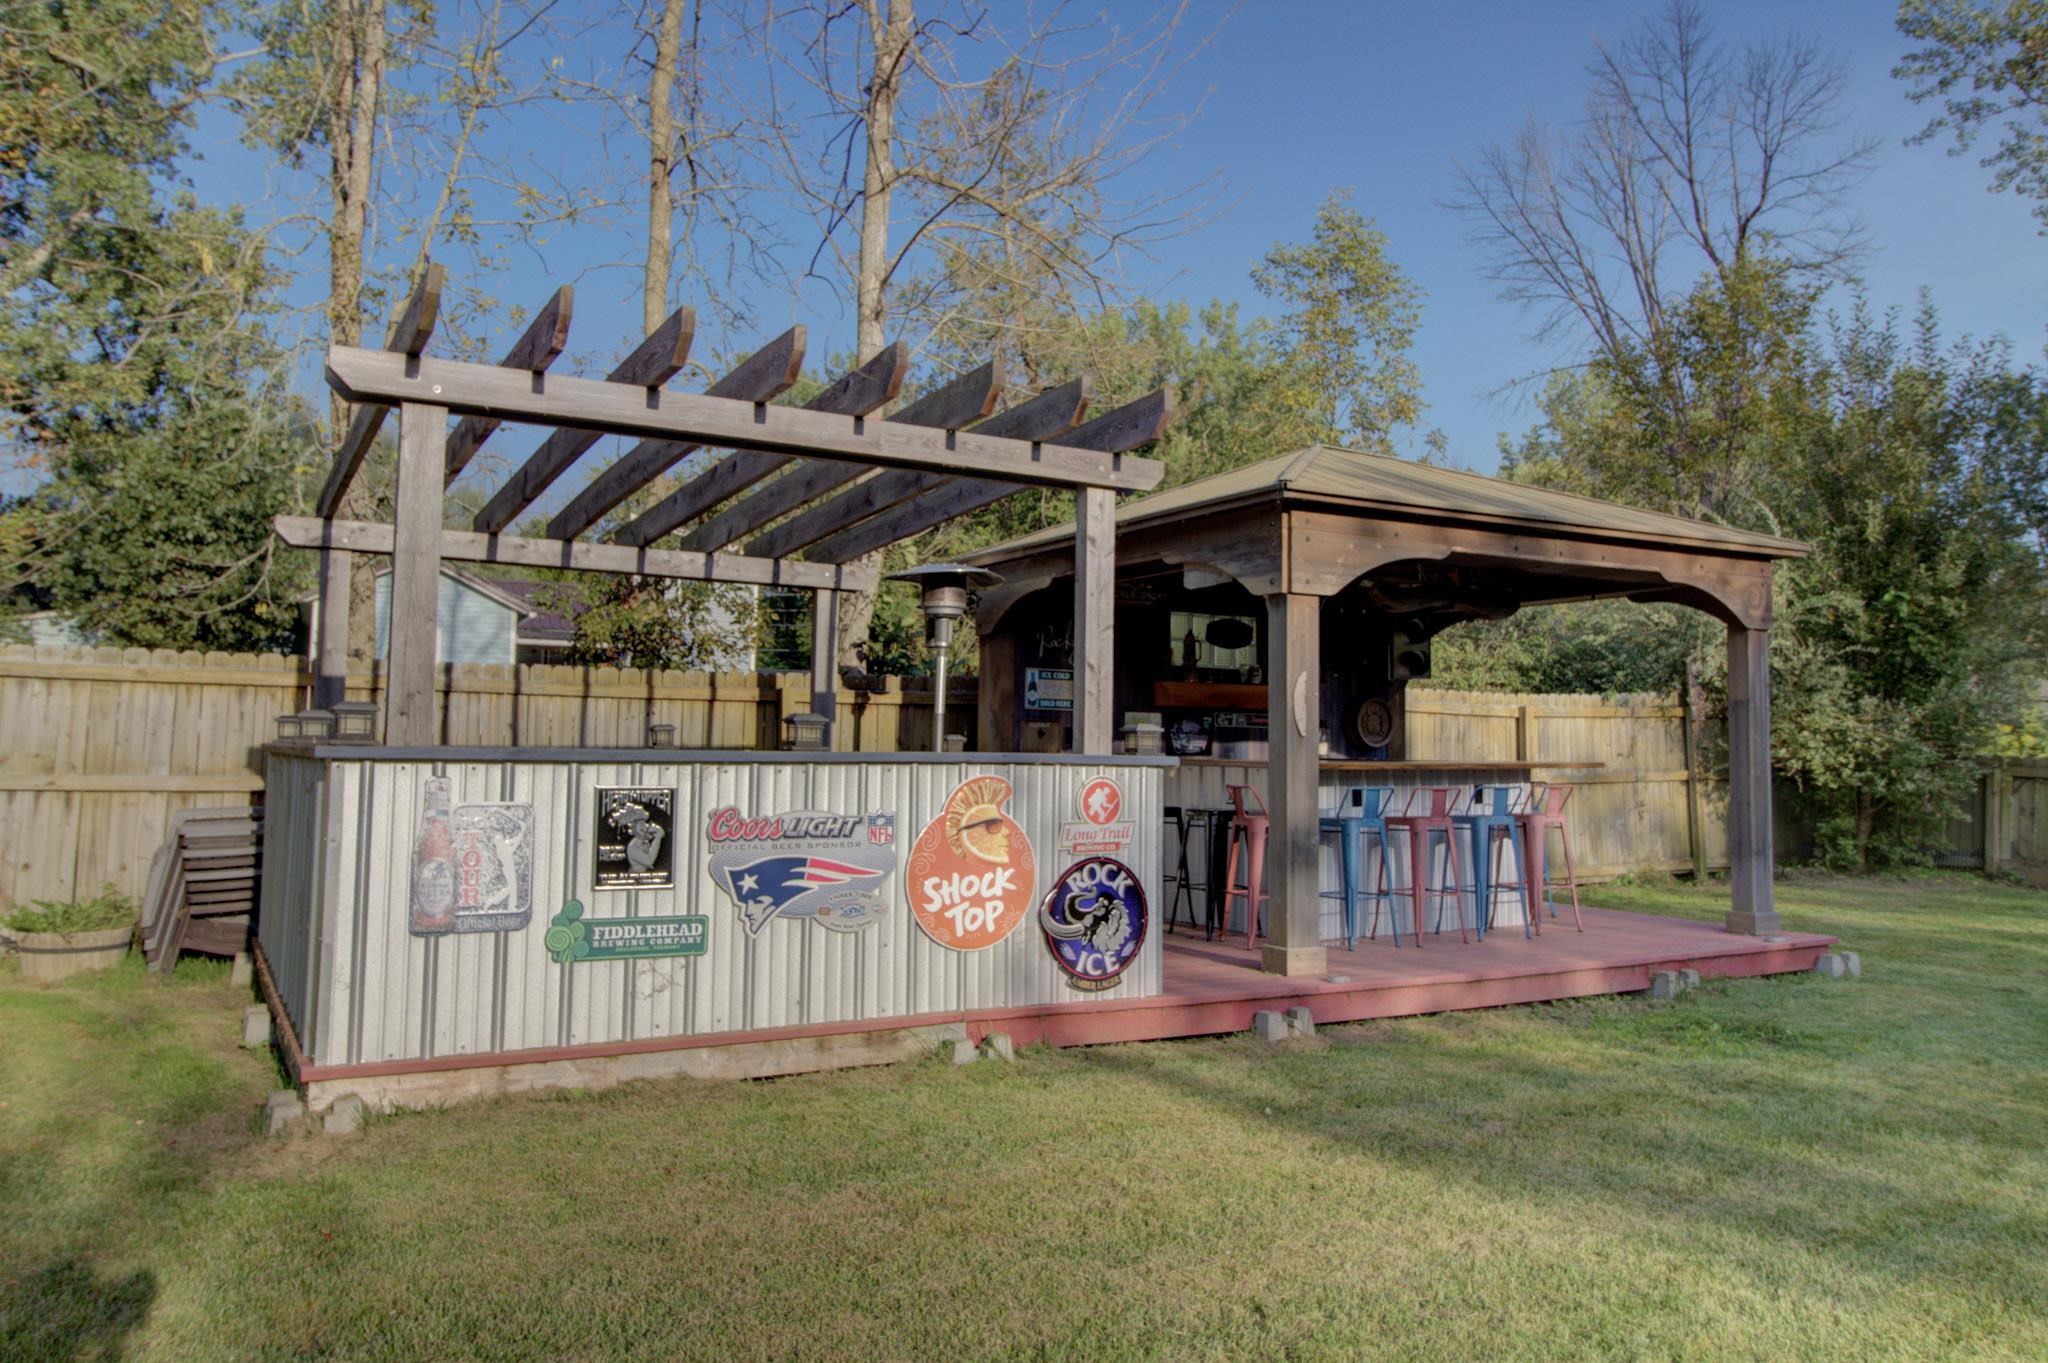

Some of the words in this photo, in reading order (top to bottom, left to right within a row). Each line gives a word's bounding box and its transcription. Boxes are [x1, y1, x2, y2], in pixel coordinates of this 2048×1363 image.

[1041, 671, 1052, 679] ICE
[1053, 671, 1071, 679] COLD
[710, 807, 785, 841] Coors
[783, 816, 862, 839] LIGHT
[1065, 827, 1098, 842] Long
[1101, 825, 1132, 840] Trail
[868, 825, 893, 844] NFL
[712, 844, 765, 852] OFFICIAL
[772, 842, 802, 850] BEER
[807, 841, 862, 849] SPONSOR
[459, 831, 482, 908] TOUR
[922, 866, 1017, 913] SHOCK
[1065, 862, 1134, 899] ROCK
[498, 916, 522, 927] Beer
[944, 899, 1005, 938] TOP
[592, 923, 703, 940] FIDDLEHEAD
[592, 938, 645, 948] BREWING
[649, 936, 702, 946] COMPANY
[1075, 949, 1121, 976] ICE
